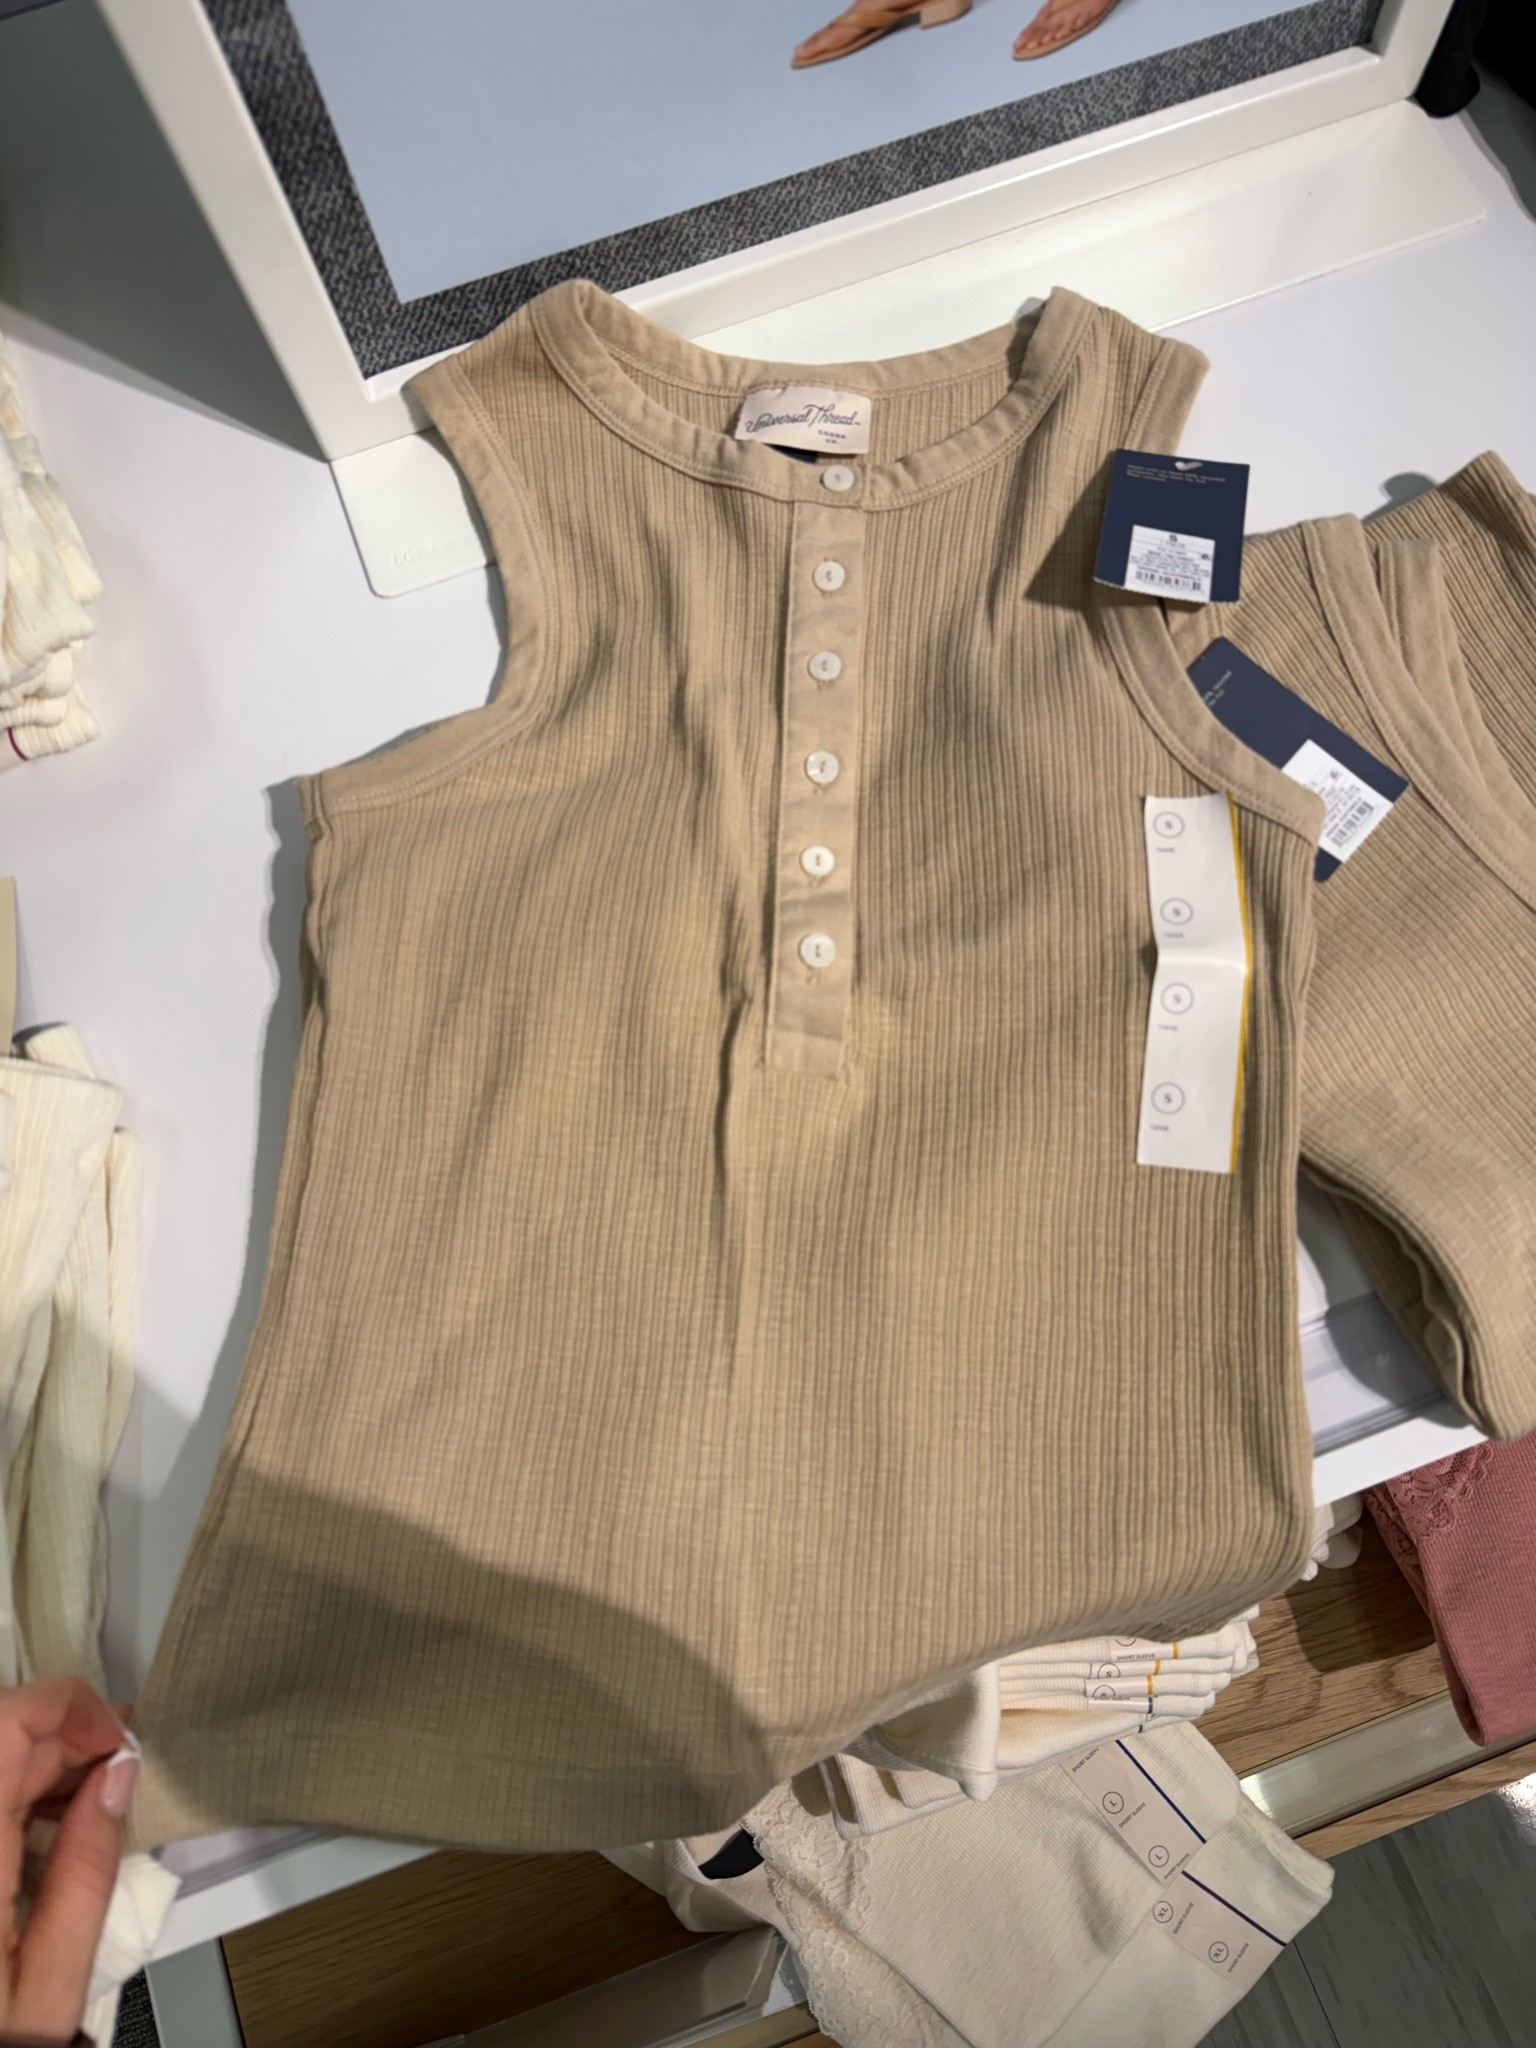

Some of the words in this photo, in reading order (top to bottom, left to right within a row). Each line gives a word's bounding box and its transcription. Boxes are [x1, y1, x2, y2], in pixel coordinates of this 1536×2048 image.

[745, 409, 810, 433] Universal
[803, 404, 861, 427] Thread
[1072, 1759, 1086, 1772] SHORT
[1119, 1814, 1132, 1828] SHORT
[1131, 1802, 1146, 1816] SLEEVE
[1164, 1866, 1177, 1880] SHORT
[1176, 1853, 1190, 1867] SLEEVE
[1158, 1907, 1169, 1919] XL
[1173, 1919, 1184, 1935] SHORT
[1182, 1902, 1194, 1920] SLEEVE
[1213, 1947, 1224, 1959] XL
[1228, 1957, 1239, 1973] SHORT
[1237, 1942, 1249, 1958] SLEEVE
